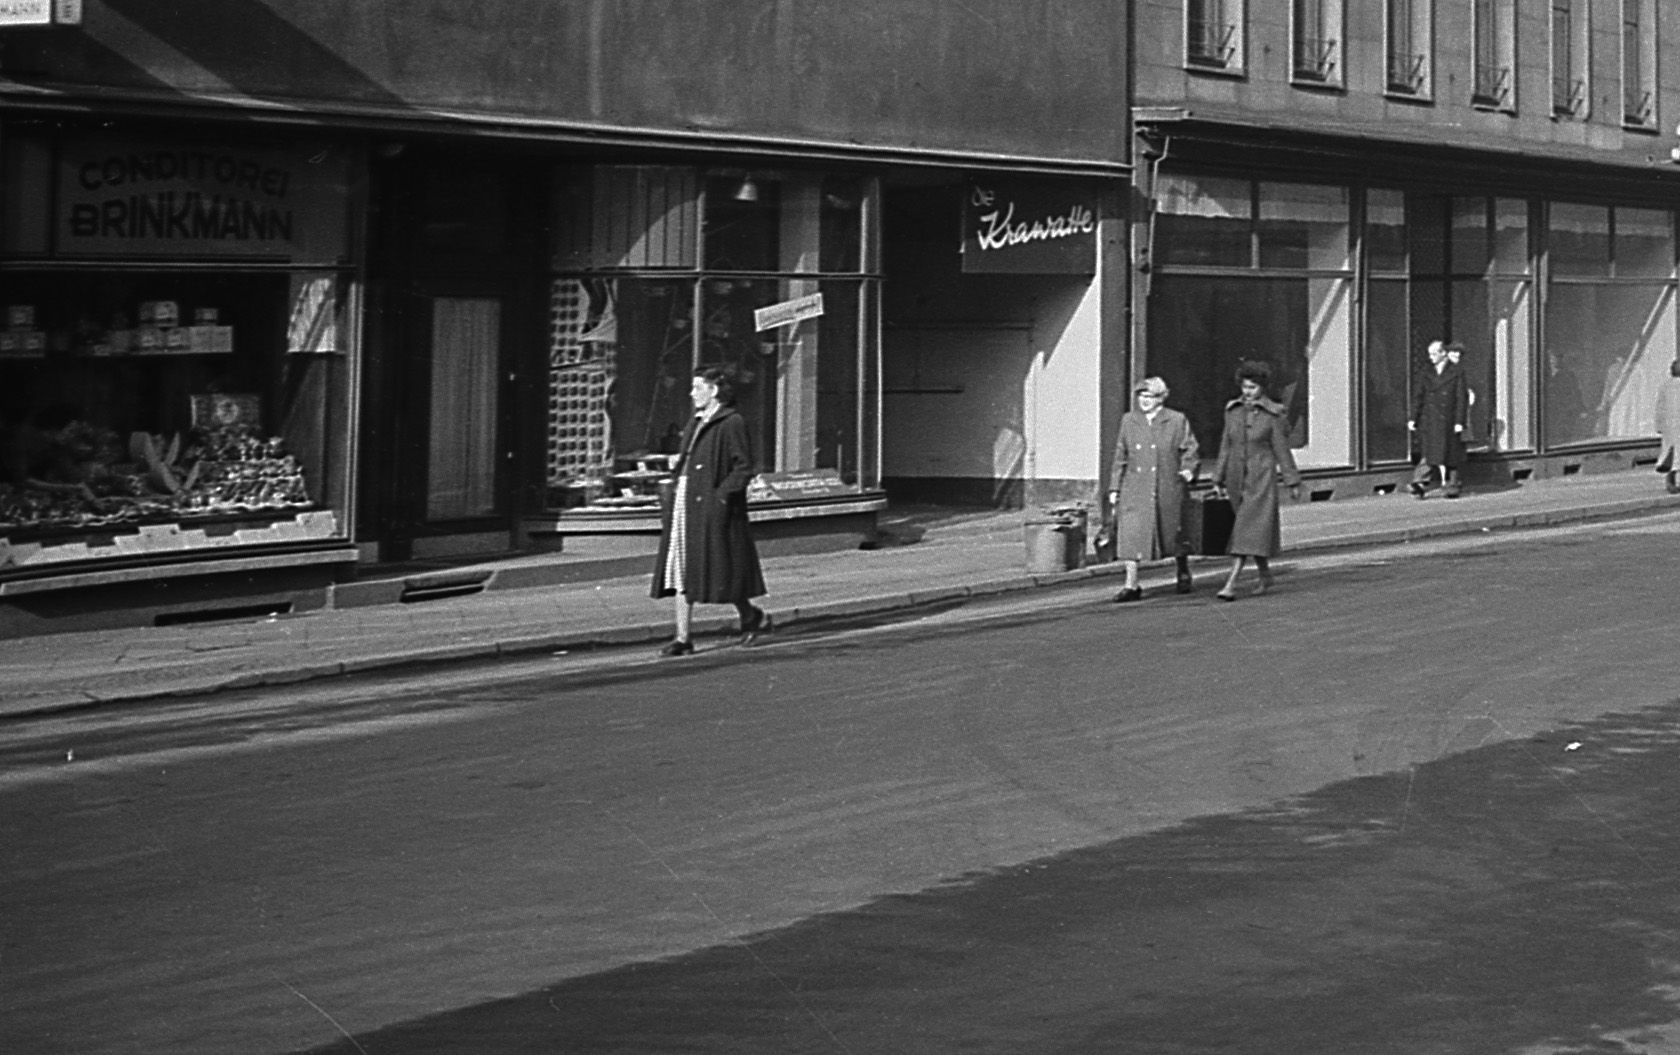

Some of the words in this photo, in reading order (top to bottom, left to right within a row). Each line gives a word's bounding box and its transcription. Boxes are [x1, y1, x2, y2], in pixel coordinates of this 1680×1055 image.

[79, 150, 290, 198] CONDITOREI
[69, 191, 293, 241] BRINKMANN
[977, 202, 1095, 250] Krawatte
